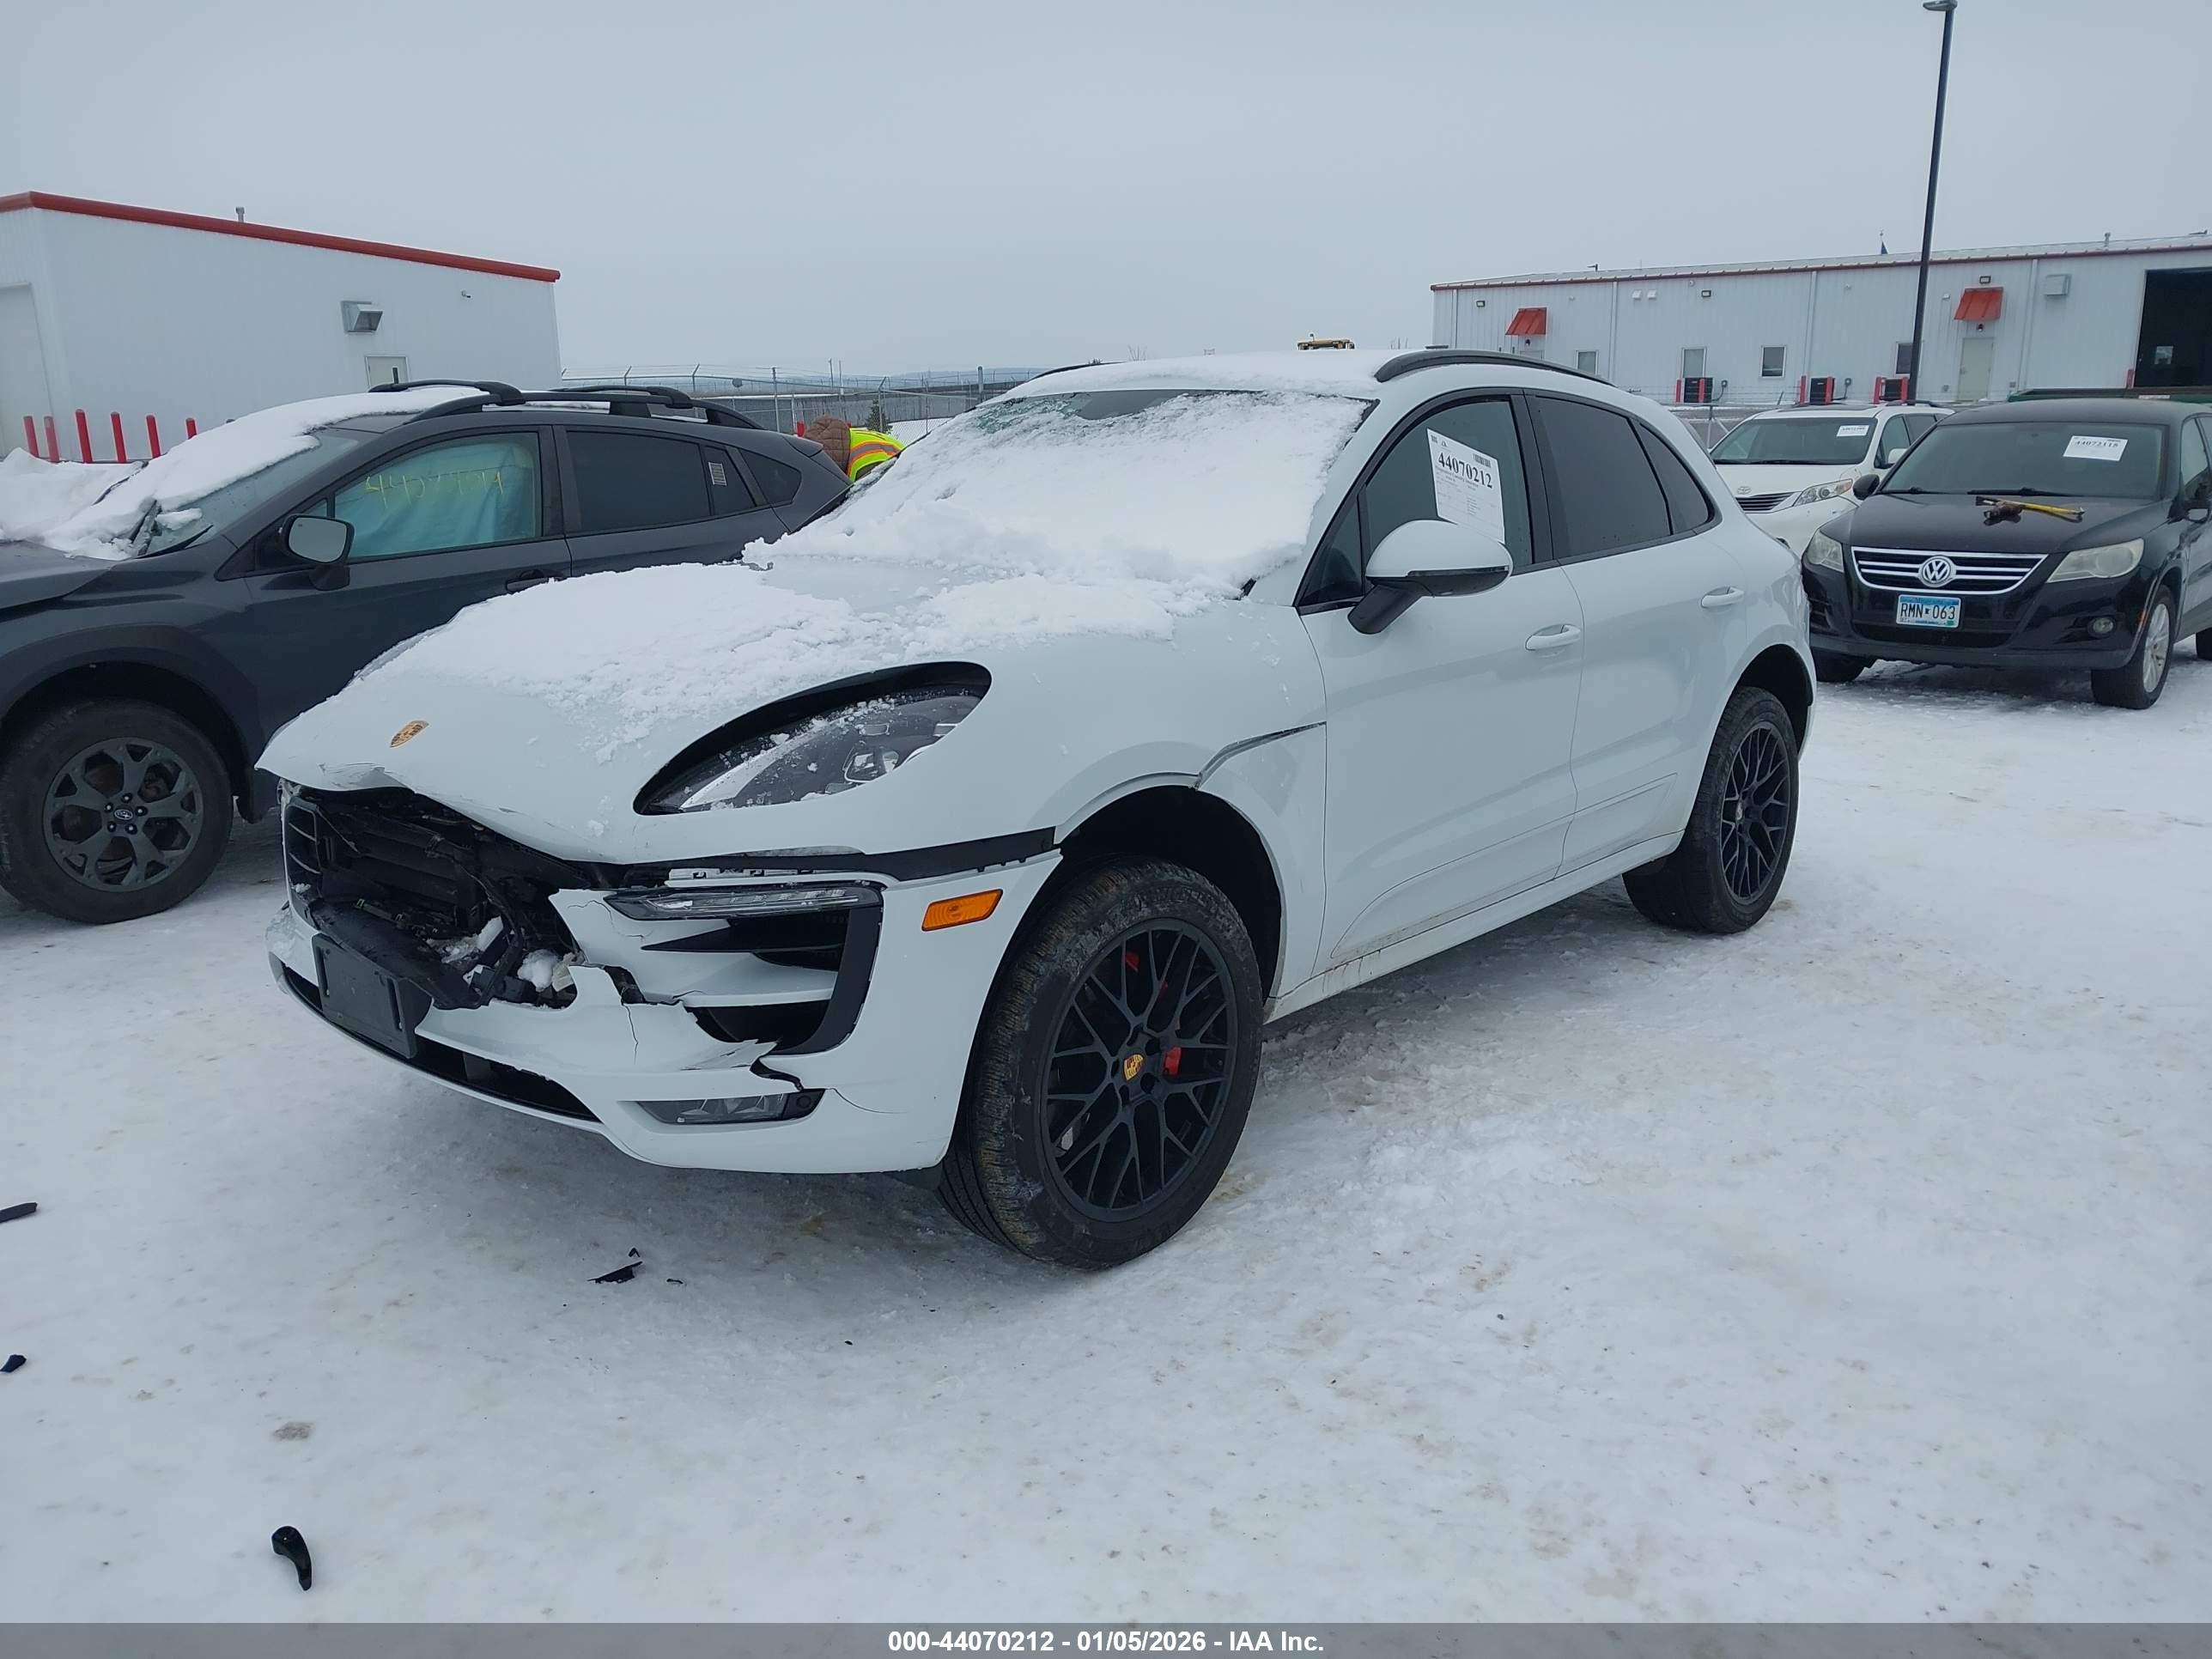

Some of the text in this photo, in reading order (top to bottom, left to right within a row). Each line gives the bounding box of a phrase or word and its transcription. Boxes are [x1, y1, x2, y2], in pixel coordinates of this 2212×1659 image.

[1437, 452, 1492, 489] 44070212
[1900, 603, 1956, 620] RMN 063
